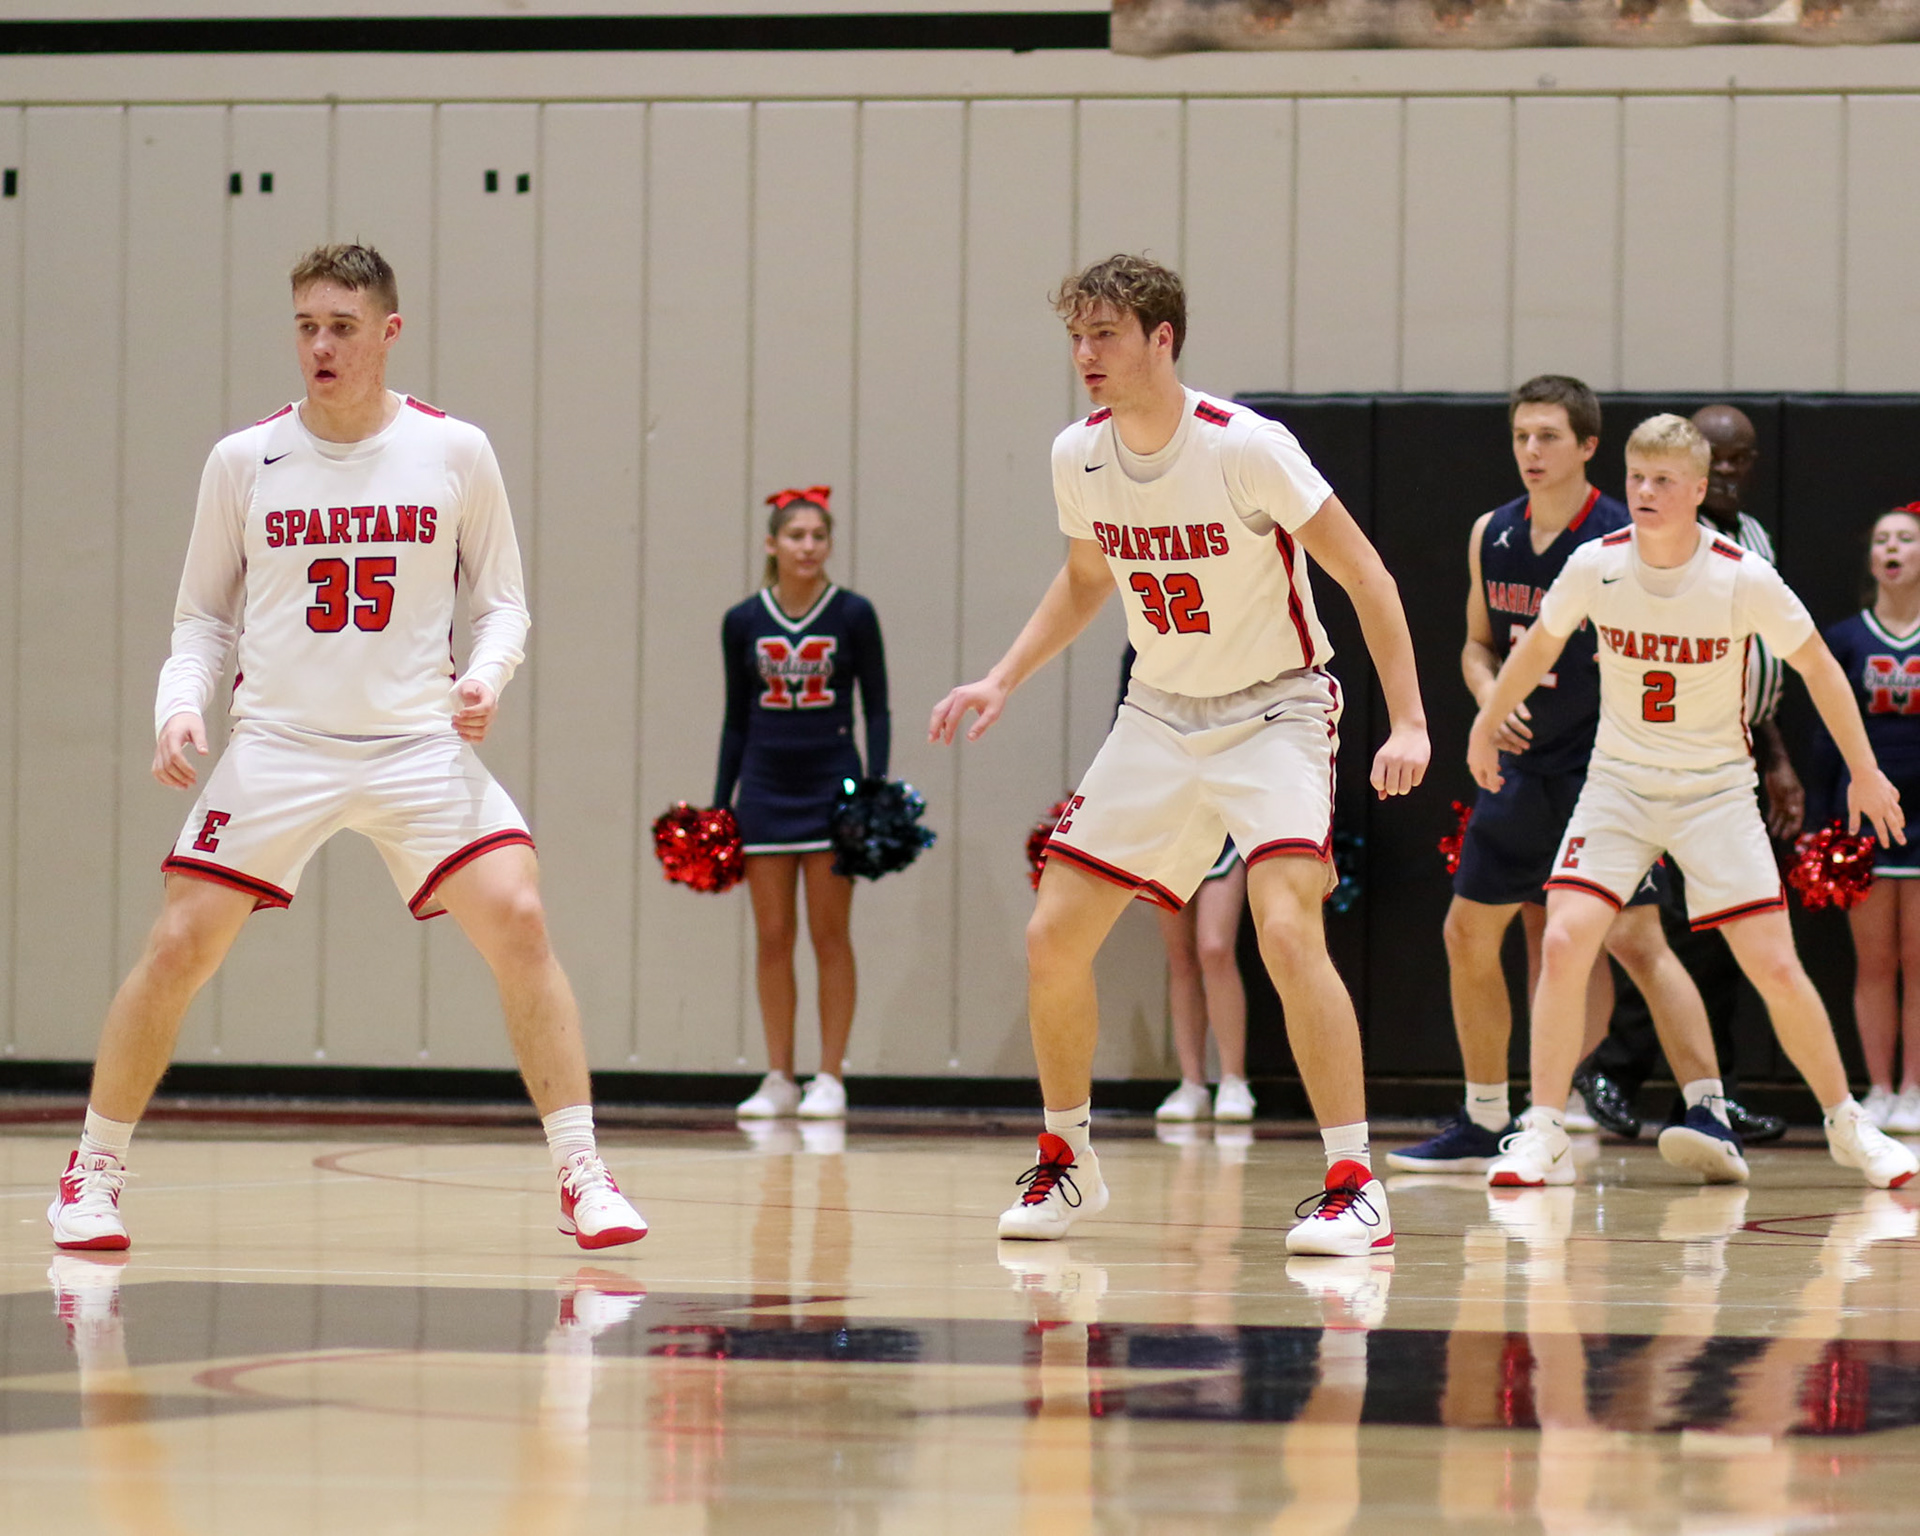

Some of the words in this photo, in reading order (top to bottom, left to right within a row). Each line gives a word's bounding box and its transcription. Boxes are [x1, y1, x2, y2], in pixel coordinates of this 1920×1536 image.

[266, 505, 437, 548] SPARTANS
[1093, 520, 1230, 562] SPARTANS
[306, 556, 397, 633] 35
[1129, 571, 1212, 635] 32
[1599, 625, 1731, 664] SPARTANS
[756, 635, 837, 709] M
[1642, 670, 1677, 723] 2
[192, 810, 232, 854] E
[1055, 795, 1086, 835] E
[1561, 836, 1585, 869] E
